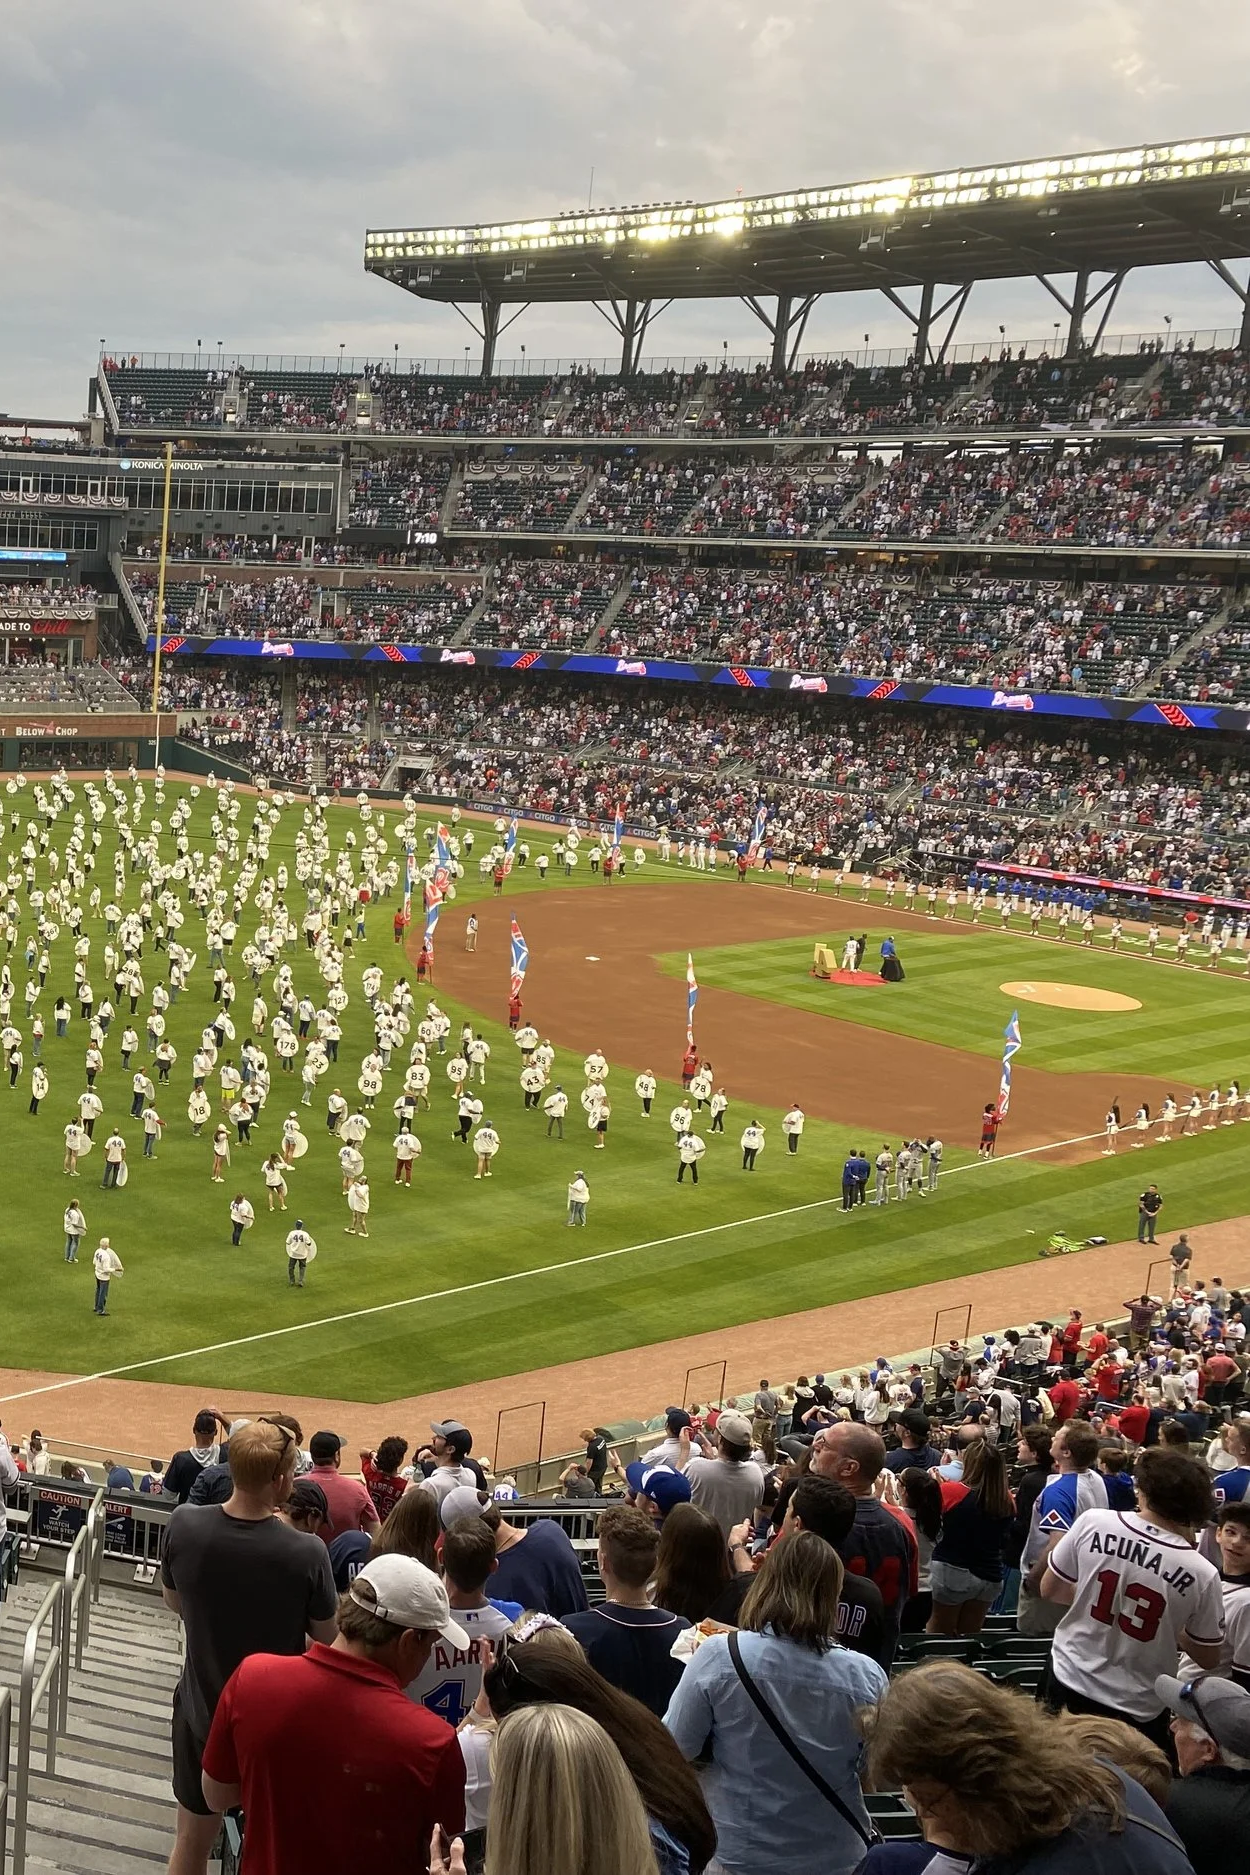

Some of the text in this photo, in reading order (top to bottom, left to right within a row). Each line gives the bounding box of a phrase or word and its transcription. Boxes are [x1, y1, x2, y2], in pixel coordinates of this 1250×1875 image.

[131, 460, 164, 469] KONICA
[19, 622, 31, 631] TO
[32, 620, 72, 635] Chill
[15, 727, 78, 736] BELOW CHOP
[474, 803, 493, 812] CITGO
[504, 808, 524, 817] CITGO
[535, 813, 555, 822] CITGO
[633, 829, 656, 838] CITGO
[334, 996, 346, 1004] 127
[280, 1041, 296, 1050] 178
[312, 1058, 324, 1069] 23
[535, 1055, 547, 1065] 85
[451, 1065, 462, 1076] 95
[590, 1065, 603, 1074] 57
[411, 1072, 424, 1081] 83
[526, 1076, 540, 1087] 43
[36, 1082, 44, 1092] 14
[363, 1080, 377, 1089] 98
[639, 1082, 649, 1091] 48
[695, 1082, 706, 1093] 78
[585, 1094, 595, 1107] 74
[194, 1106, 205, 1116] 18
[674, 1113, 685, 1125] 96
[40, 1491, 80, 1505] CAUTION
[105, 1503, 128, 1514] ALERT
[43, 1524, 60, 1532] YOUR
[49, 1520, 70, 1528] WATCH
[1089, 1532, 1196, 1597] ACUÑA JR.
[1091, 1569, 1166, 1642] 13
[435, 1640, 501, 1671] AAR
[421, 1679, 475, 1728] 4
